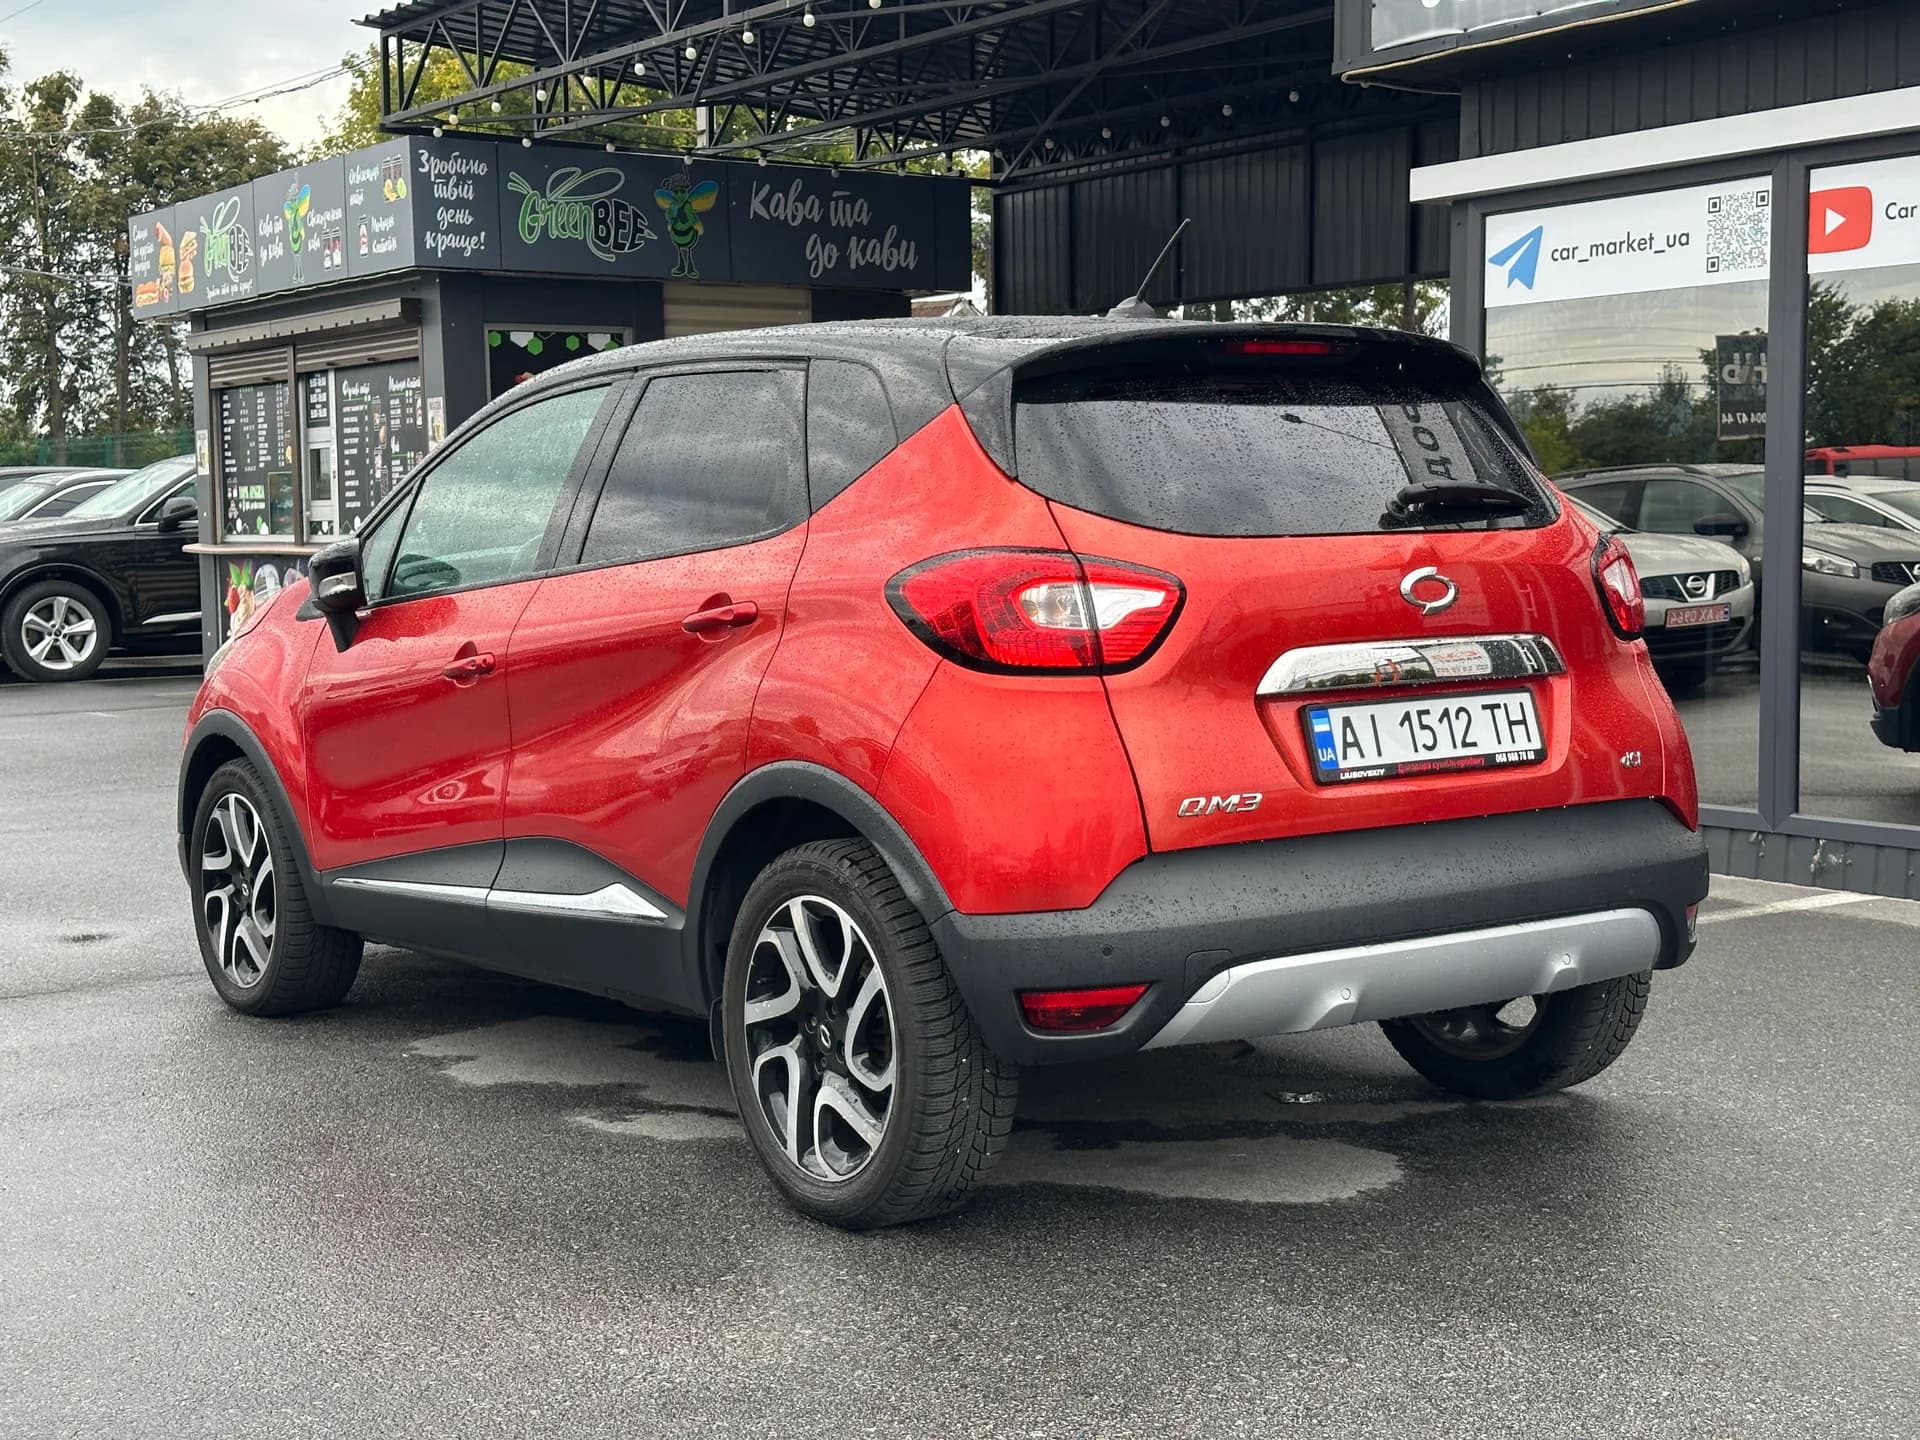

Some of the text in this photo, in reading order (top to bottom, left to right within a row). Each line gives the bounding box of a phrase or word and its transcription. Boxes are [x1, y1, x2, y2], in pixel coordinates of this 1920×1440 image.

[417, 149, 489, 182] Зробимо
[433, 175, 475, 201] твій
[436, 206, 475, 230] день
[749, 180, 872, 228] Кава та
[1885, 202, 1918, 220] Car
[423, 231, 486, 258] краще!
[805, 232, 919, 278] до кави
[1550, 230, 1690, 263] car_market_ua
[1318, 701, 1532, 762] UA AI 1512 TH
[1177, 792, 1263, 817] QM3
